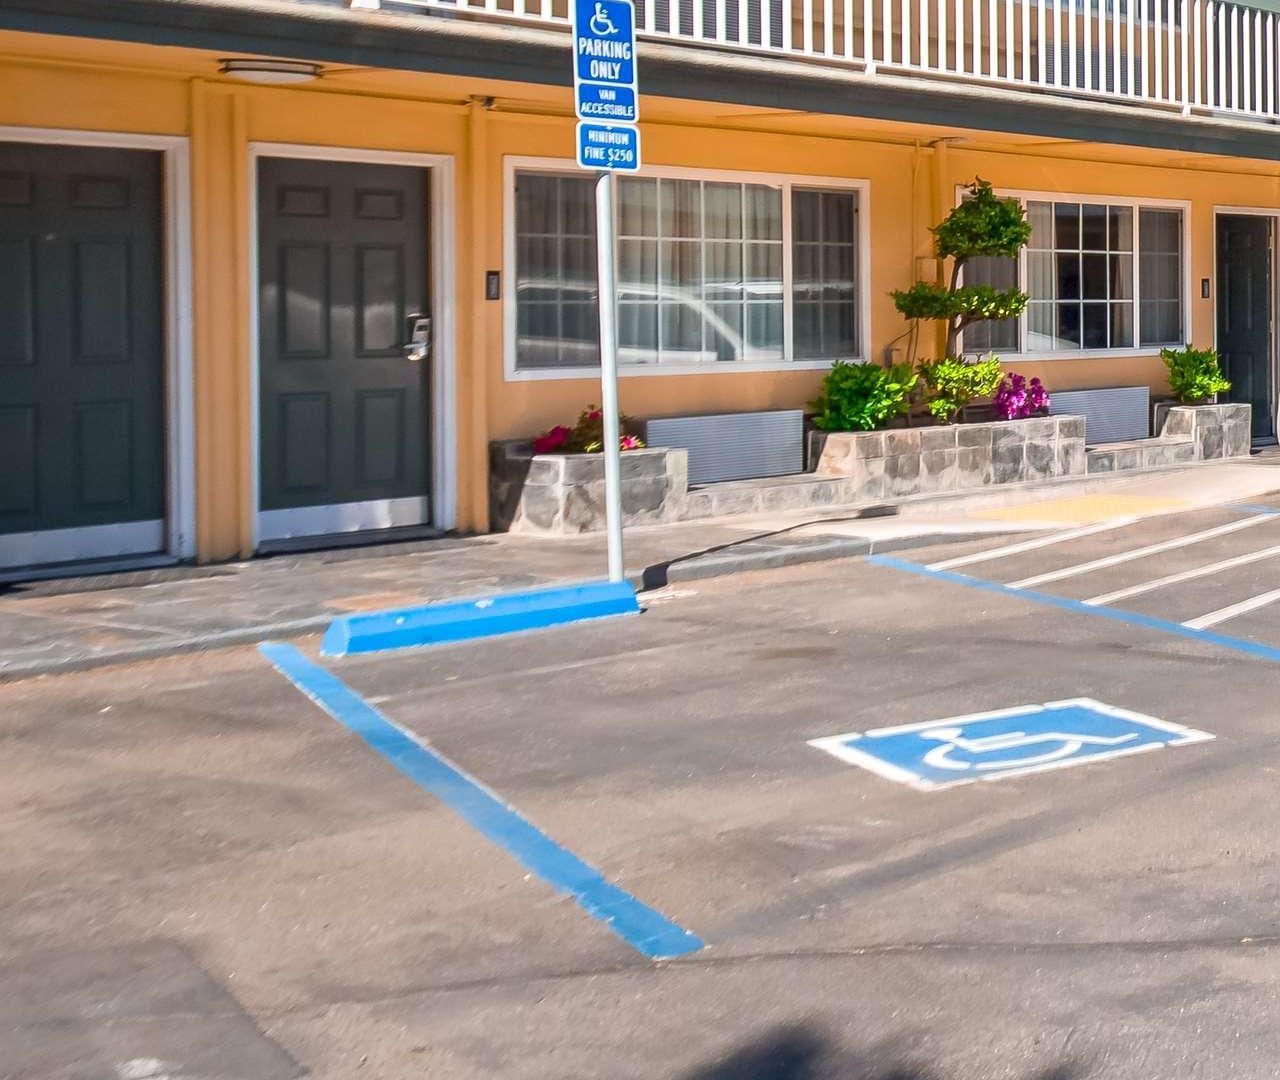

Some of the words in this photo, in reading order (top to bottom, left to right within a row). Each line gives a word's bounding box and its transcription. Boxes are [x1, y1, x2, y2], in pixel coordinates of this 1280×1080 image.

[579, 37, 631, 60] PARKING
[590, 60, 621, 80] ONLY
[598, 89, 616, 101] VAN
[581, 102, 634, 117] ACCESSIBLE
[588, 130, 629, 145] MINIMUM
[584, 146, 606, 160] FINE
[607, 148, 633, 162] $250
